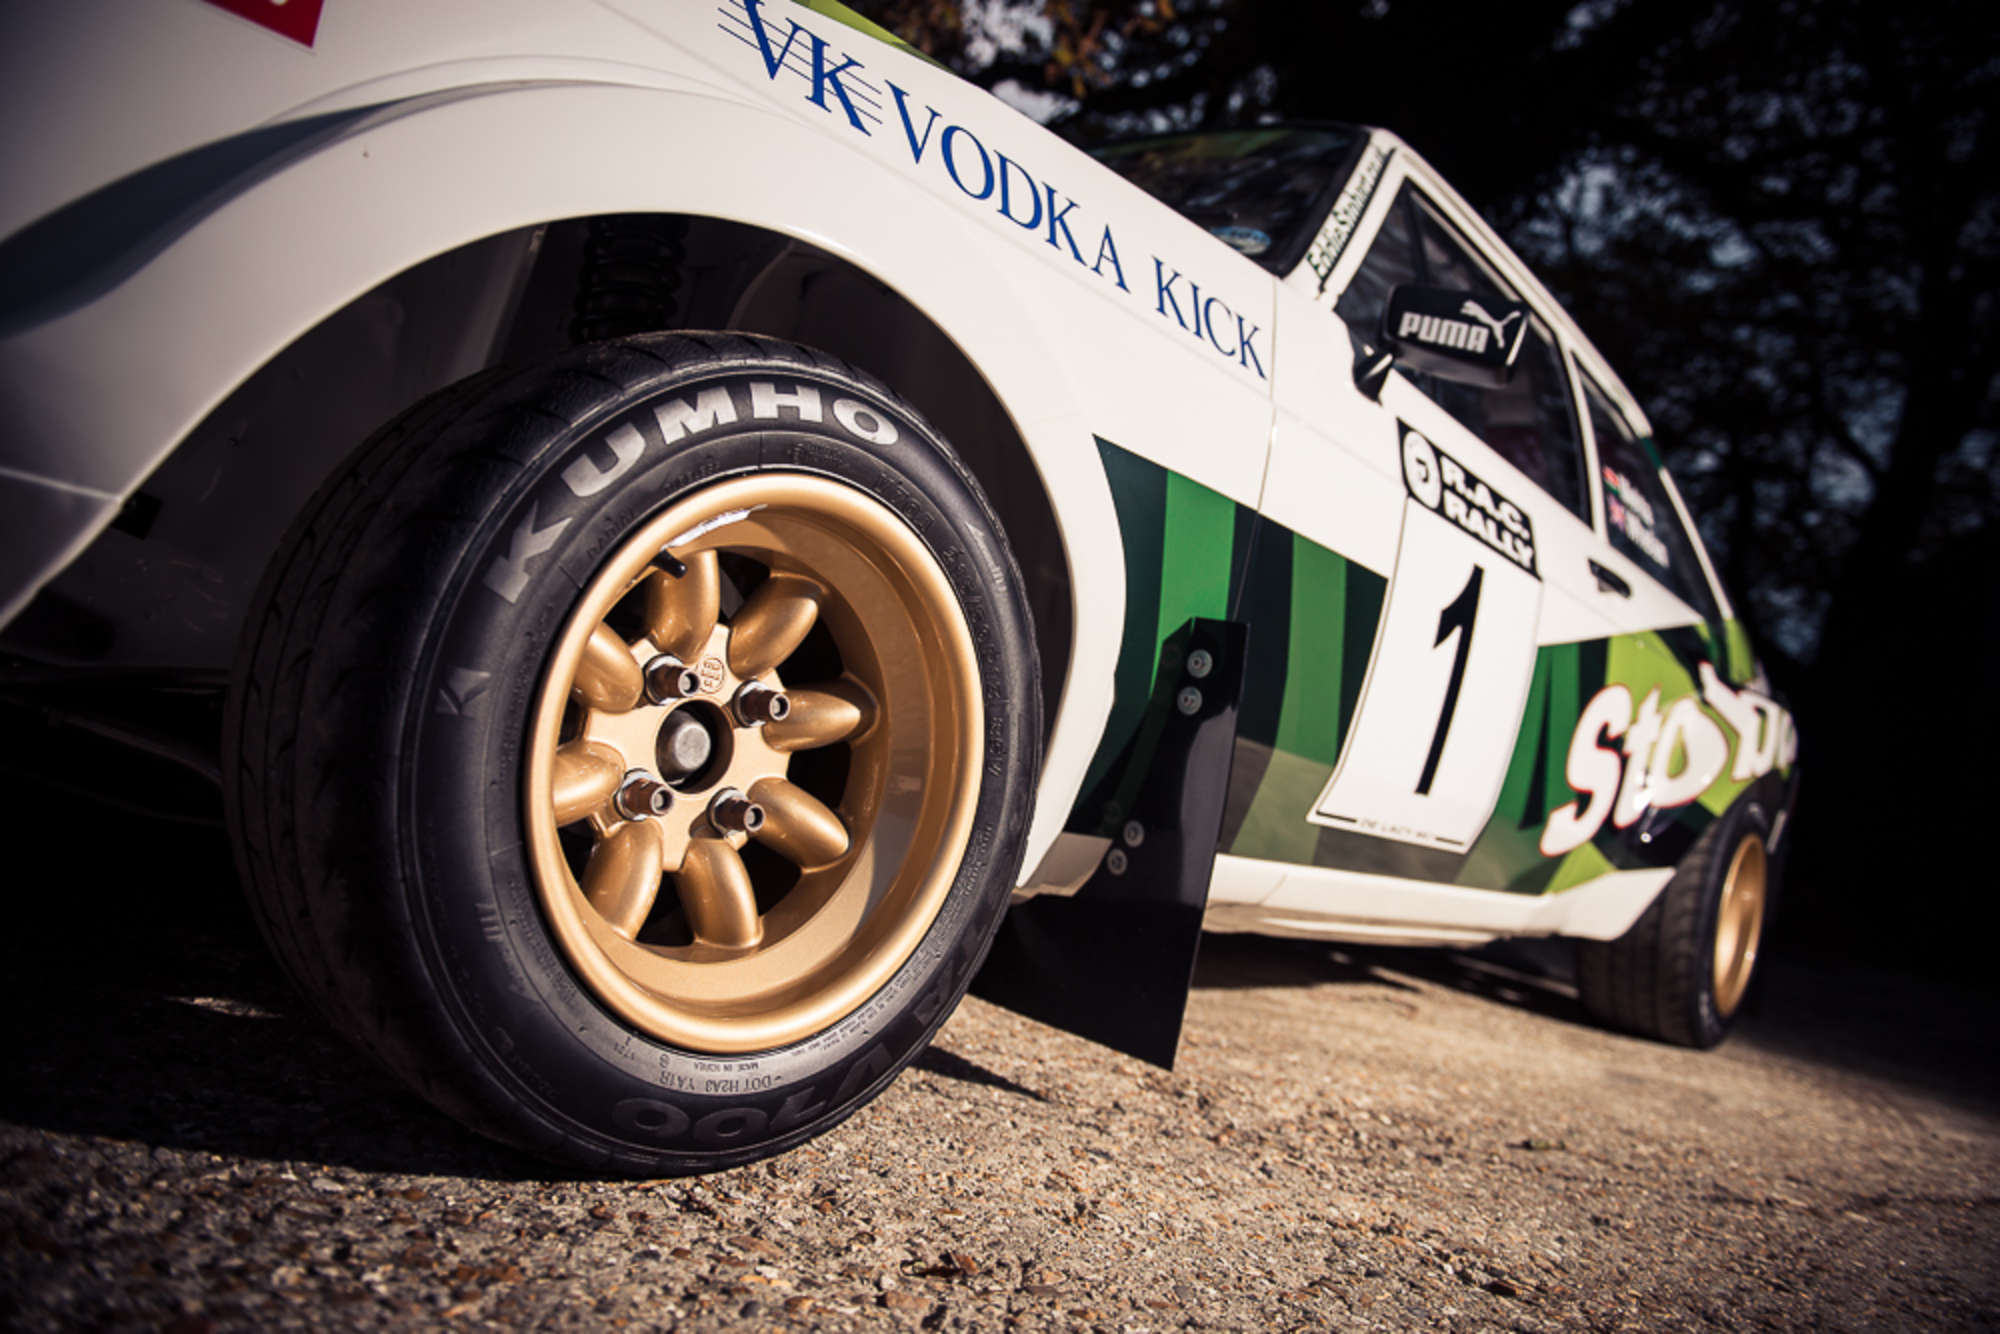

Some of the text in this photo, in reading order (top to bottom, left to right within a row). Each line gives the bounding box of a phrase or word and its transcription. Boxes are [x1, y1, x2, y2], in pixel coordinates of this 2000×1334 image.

[726, 0, 1267, 381] VK VODKA KICK
[1398, 311, 1489, 354] PUMA
[485, 382, 899, 604] KUMHO
[1443, 489, 1533, 569] RALLY
[1433, 564, 1485, 796] 1
[742, 1074, 773, 1092] DOT
